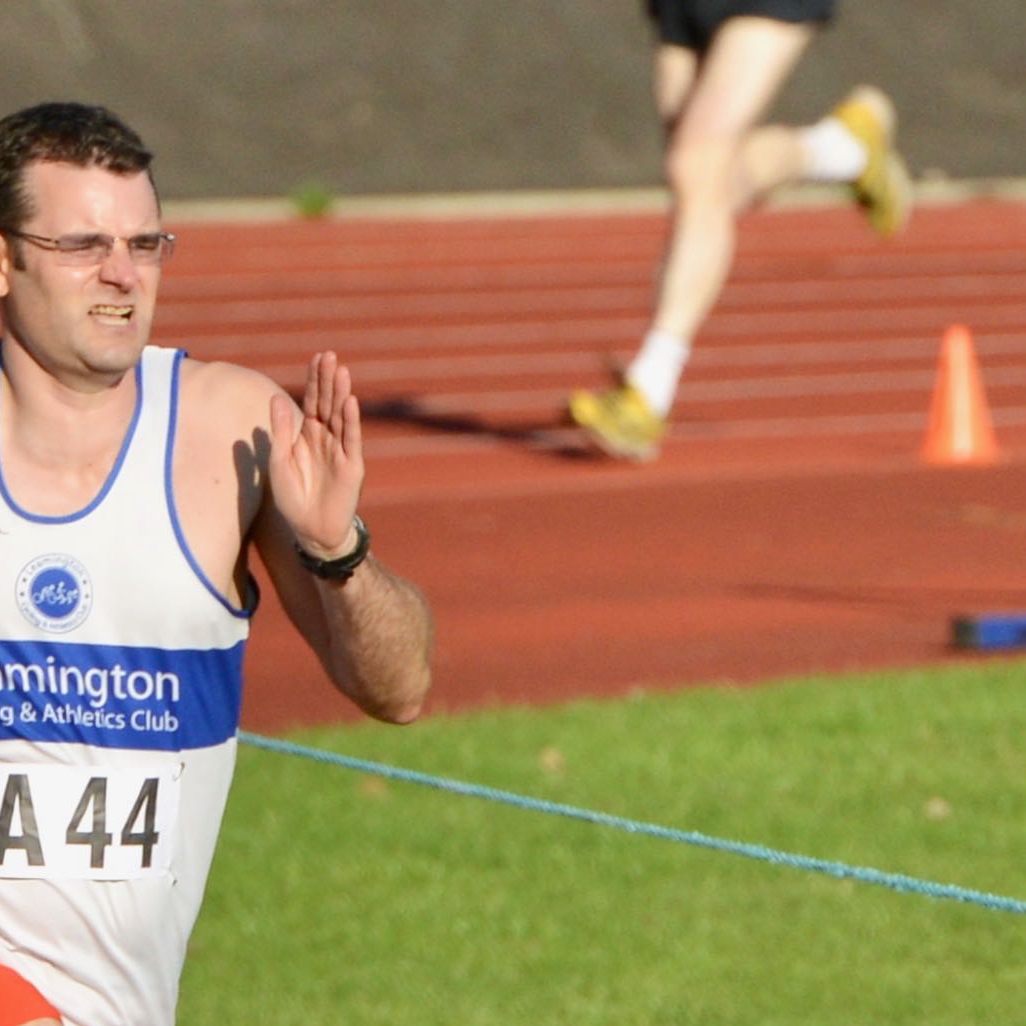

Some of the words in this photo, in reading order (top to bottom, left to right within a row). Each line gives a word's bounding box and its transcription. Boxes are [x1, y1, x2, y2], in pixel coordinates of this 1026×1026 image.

[19, 702, 37, 723] &
[41, 703, 126, 730] Athletics
[130, 709, 179, 732] Club
[65, 776, 160, 870] 44
